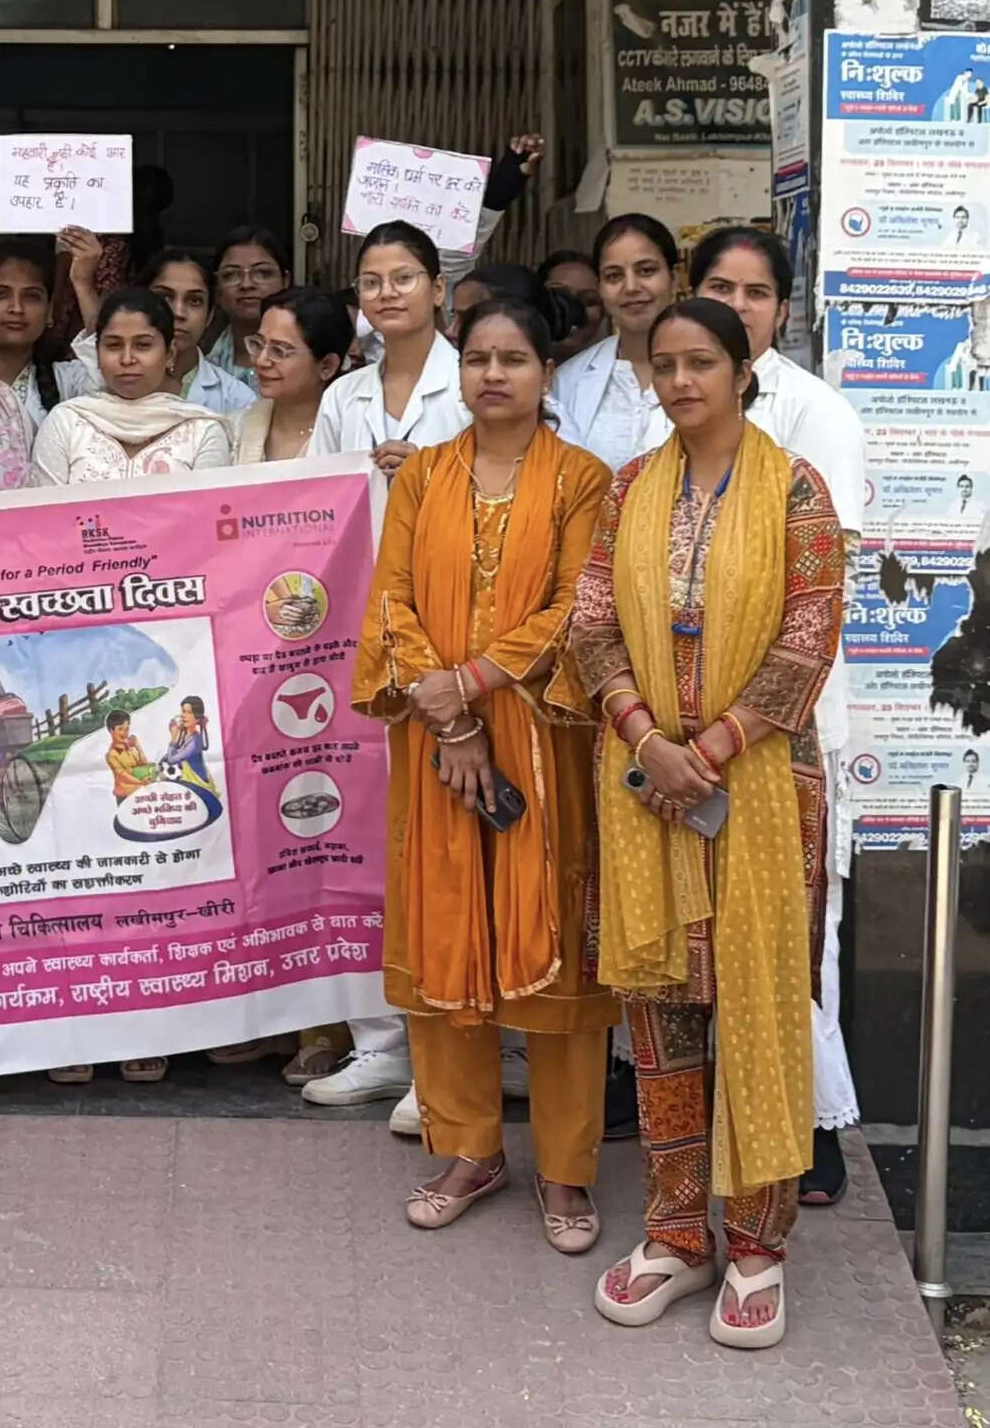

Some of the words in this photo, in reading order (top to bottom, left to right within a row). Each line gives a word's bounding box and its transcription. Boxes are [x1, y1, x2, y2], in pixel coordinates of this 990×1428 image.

[659, 10, 710, 38] नजर
[716, 2, 739, 37] में
[618, 51, 652, 67] CCTV
[622, 77, 662, 92] Ateek
[666, 76, 716, 91] Ahmad
[242, 509, 335, 529] NUTRITION
[1, 568, 20, 581] for
[25, 570, 33, 578] a
[38, 561, 85, 577] Period
[120, 572, 206, 609] दिवस
[27, 860, 71, 875] स्वास्थ्य
[76, 856, 91, 870] की
[97, 852, 150, 869] जानकारी
[156, 850, 167, 864] से
[52, 880, 68, 891] का
[9, 911, 103, 940] चिकित्सालय
[1, 956, 37, 976] अपने
[43, 954, 94, 972] स्वास्थ्य
[168, 942, 212, 963] शिक्षक
[217, 933, 236, 953] एवं
[242, 924, 308, 949] अभिभावक
[312, 913, 326, 932] से
[330, 916, 356, 930] बात
[362, 910, 383, 929] करें
[70, 974, 132, 1006] राष्ट्रीय
[138, 970, 209, 996] स्वास्थ्य
[282, 946, 321, 970] उत्तर
[325, 936, 370, 962] प्रदेश
